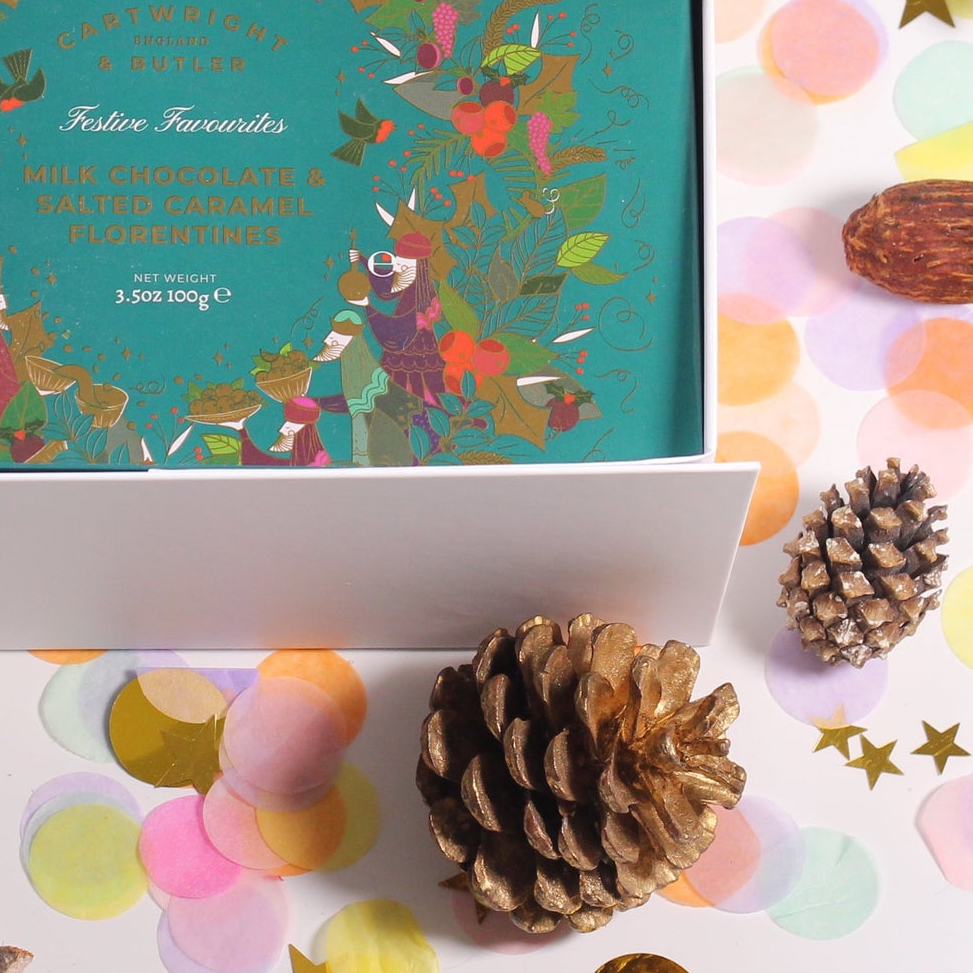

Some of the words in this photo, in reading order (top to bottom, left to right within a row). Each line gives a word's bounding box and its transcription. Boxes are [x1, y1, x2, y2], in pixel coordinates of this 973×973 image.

[56, 5, 290, 52] CARTWRIGHT
[133, 35, 210, 47] ENGLAND
[98, 55, 113, 72] &
[131, 55, 247, 73] BUTLER
[59, 103, 149, 133] Festive
[154, 104, 289, 135] Favourites
[23, 164, 98, 185] MILK
[108, 165, 296, 187] CHOCOLATE
[307, 167, 326, 187] &
[36, 194, 153, 215] SALTED
[164, 195, 314, 217] CARAMEL
[69, 223, 282, 246] FLORENTINES
[133, 272, 159, 283] NET
[164, 272, 217, 284] WEIGHT
[115, 288, 163, 304] 3.5oz
[166, 288, 210, 311] 100g
